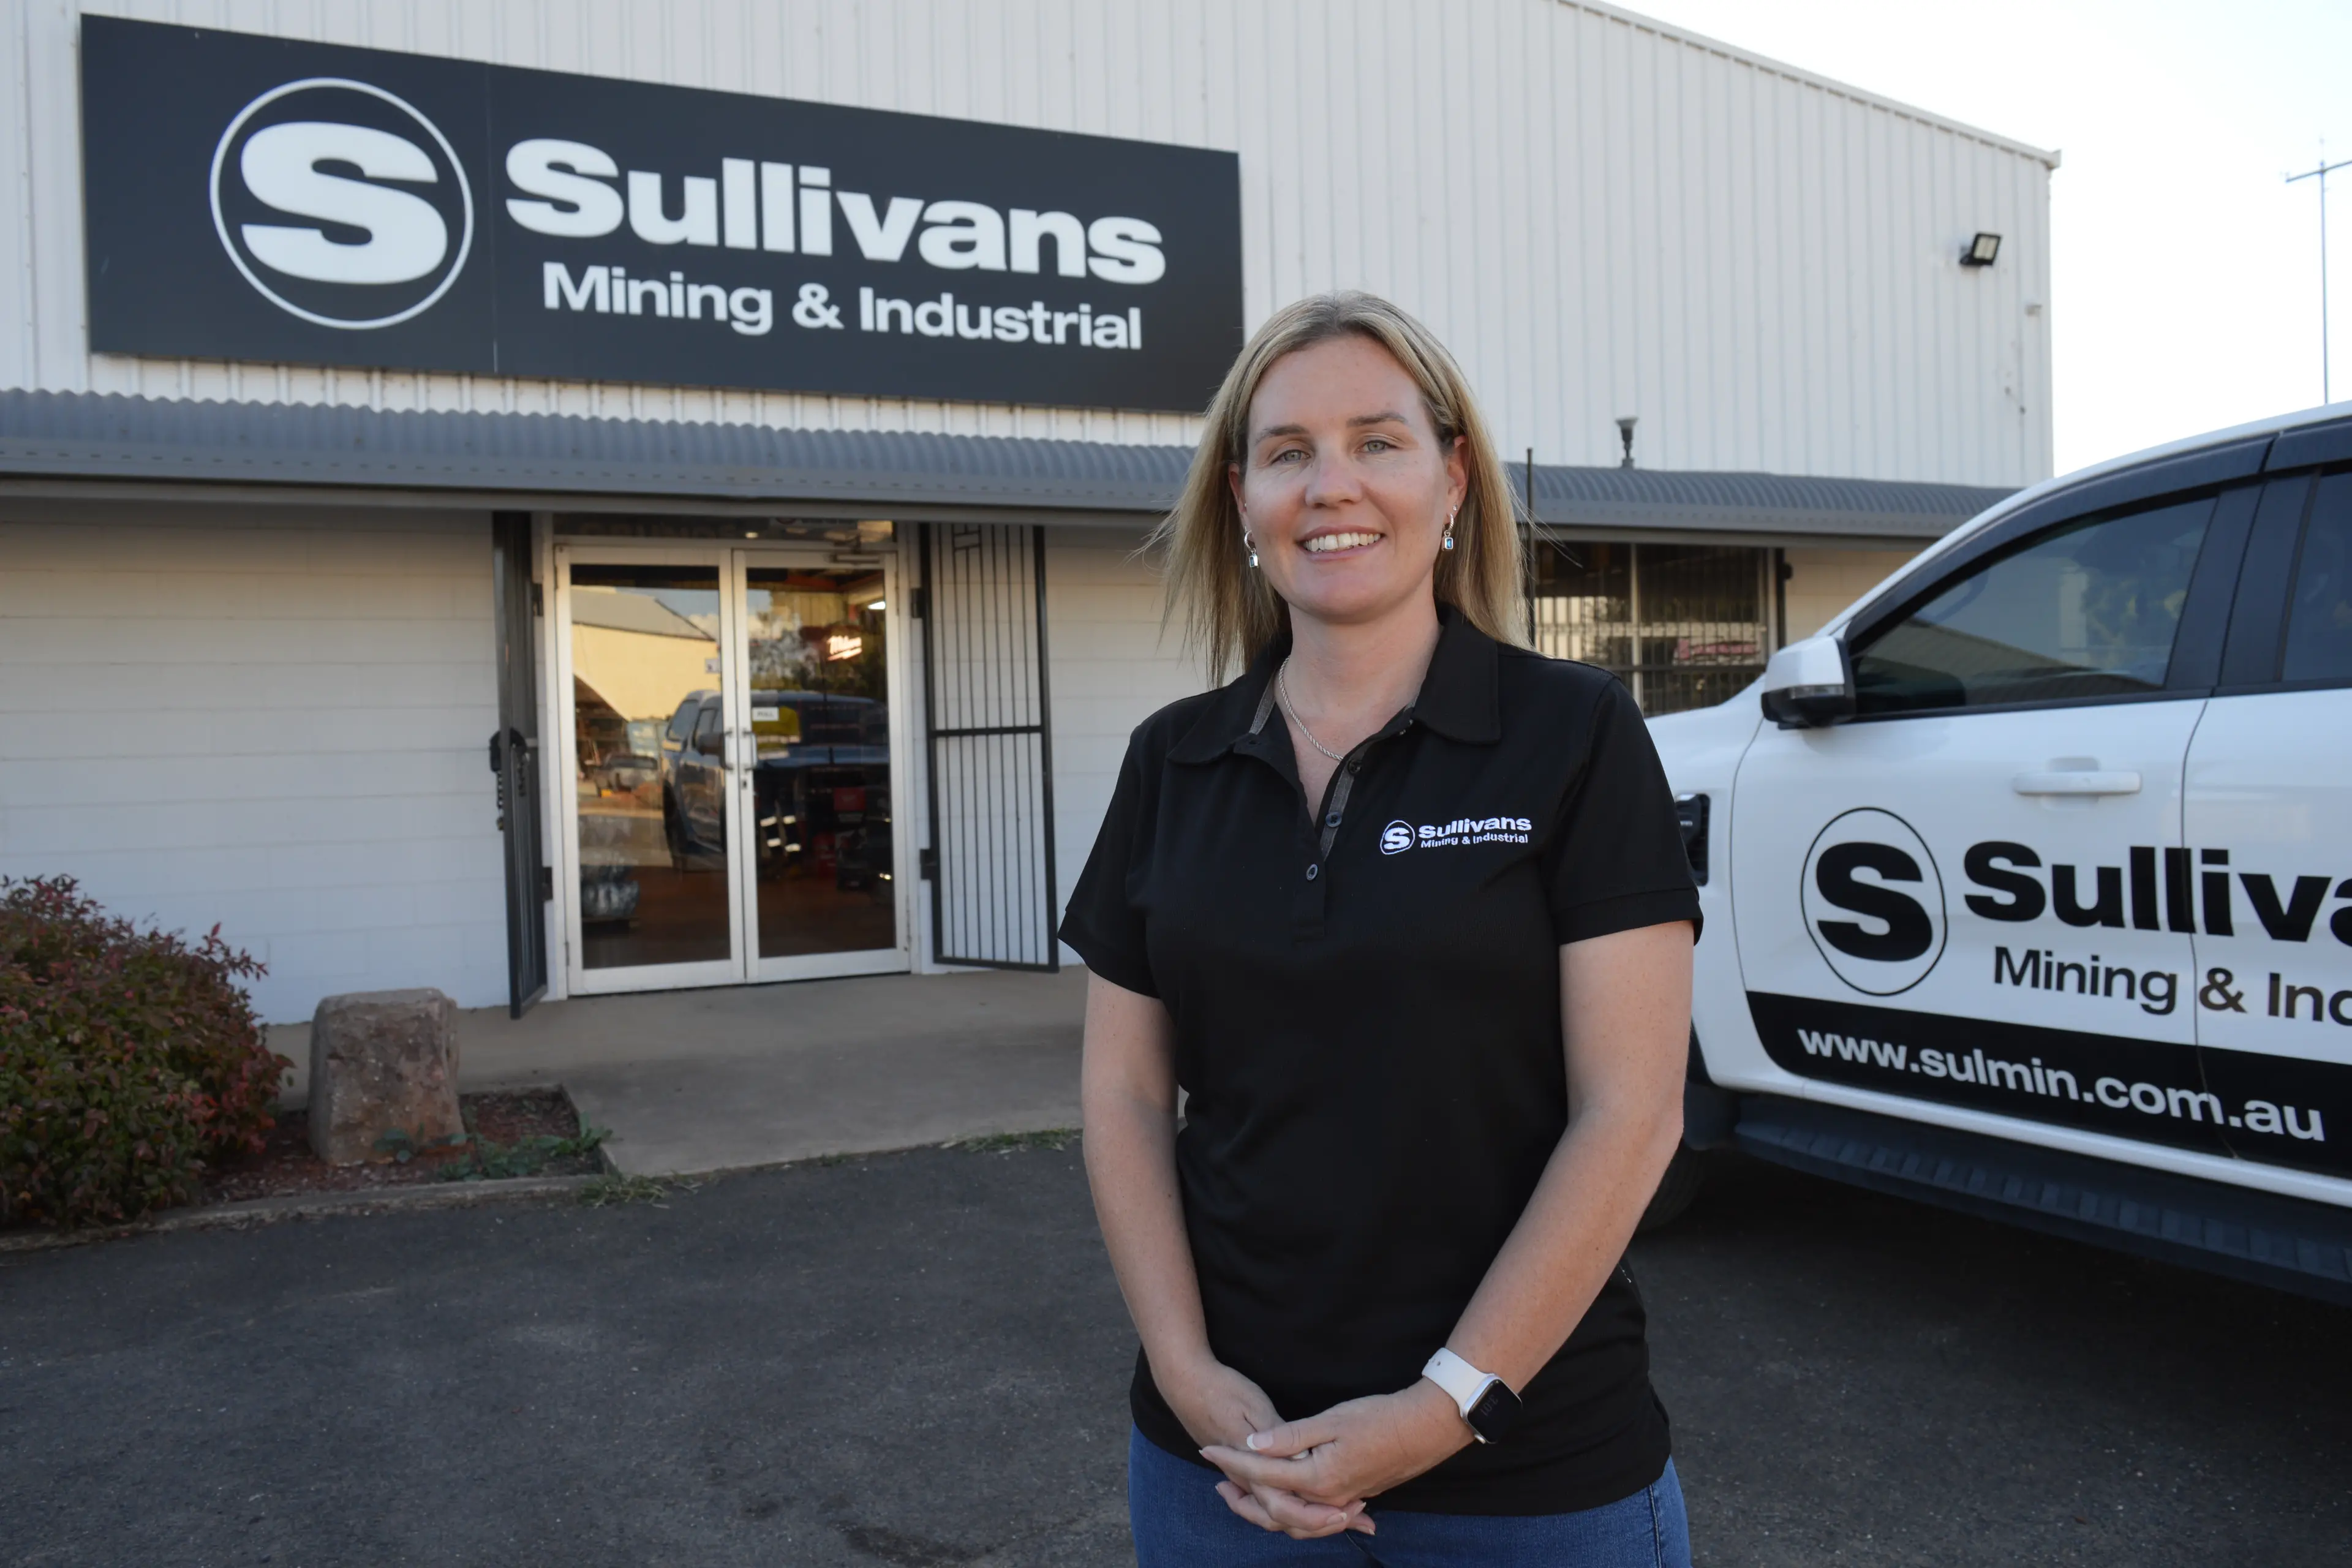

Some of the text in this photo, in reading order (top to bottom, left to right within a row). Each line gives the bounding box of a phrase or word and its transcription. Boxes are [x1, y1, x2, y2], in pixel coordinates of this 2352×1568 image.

[241, 122, 447, 284] S
[506, 139, 1166, 284] Sullivans
[543, 262, 1142, 349] Mining & Industrial
[1384, 827, 1411, 850] S
[1418, 816, 1532, 839] Sullivans
[1420, 832, 1528, 848] Mining & Industrial
[1816, 842, 1933, 962] S
[1964, 841, 2352, 948] Sulliv
[1994, 946, 2176, 1016] Mining
[2199, 968, 2246, 1014] &
[1798, 1028, 2326, 1142] www.sulmin.com.au
